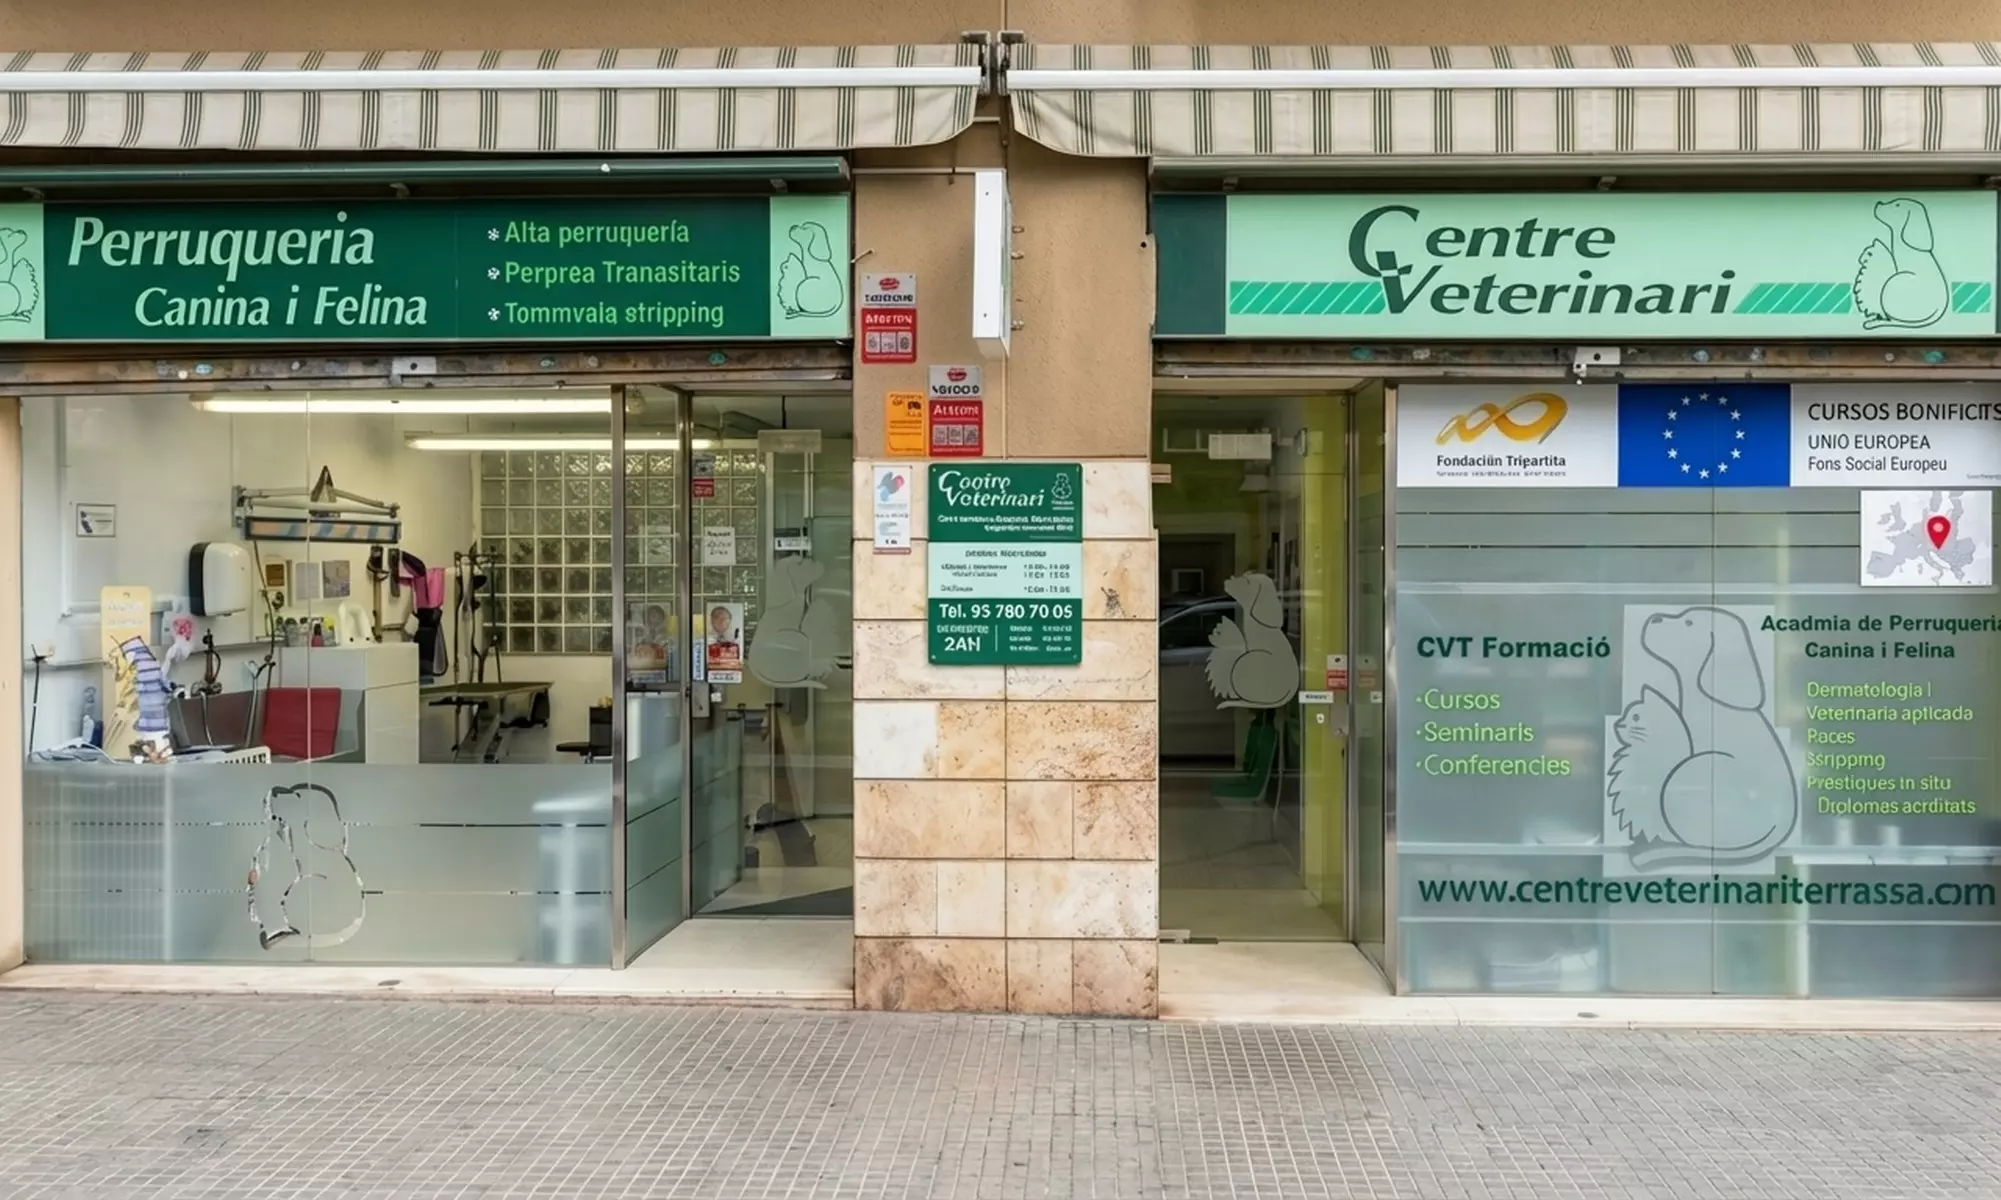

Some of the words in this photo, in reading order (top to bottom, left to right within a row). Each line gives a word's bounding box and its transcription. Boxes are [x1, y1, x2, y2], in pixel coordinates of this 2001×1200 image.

[505, 221, 551, 243] Alta
[1348, 205, 1616, 277] Centre
[68, 211, 374, 282] Perruqueria
[505, 261, 595, 288] Perprea
[602, 260, 741, 284] Tranasitaris
[1376, 251, 1736, 314] Veterinari
[135, 285, 269, 326] Canina
[286, 285, 299, 325] i
[313, 284, 428, 325] Felina
[625, 300, 724, 328] stripping
[1808, 403, 1890, 421] CURSOS
[1854, 434, 1931, 450] EUROPEA
[1808, 456, 1841, 471] Fons
[1845, 456, 1886, 471] Social
[1890, 456, 1947, 474] Europeu
[939, 604, 966, 618] Tel.
[995, 604, 1025, 619] 780
[1029, 604, 1049, 619] 70
[1761, 615, 1851, 632] Acadmia
[1858, 615, 1882, 632] de
[1417, 637, 1472, 657] CVT
[1482, 636, 1611, 658] Formació
[1805, 642, 1874, 658] Canina
[1881, 642, 1886, 658] i
[1894, 642, 1955, 658] Felina
[1424, 689, 1501, 709] Cursos
[1424, 721, 1535, 742] Seminaris
[1920, 775, 1952, 790] situ
